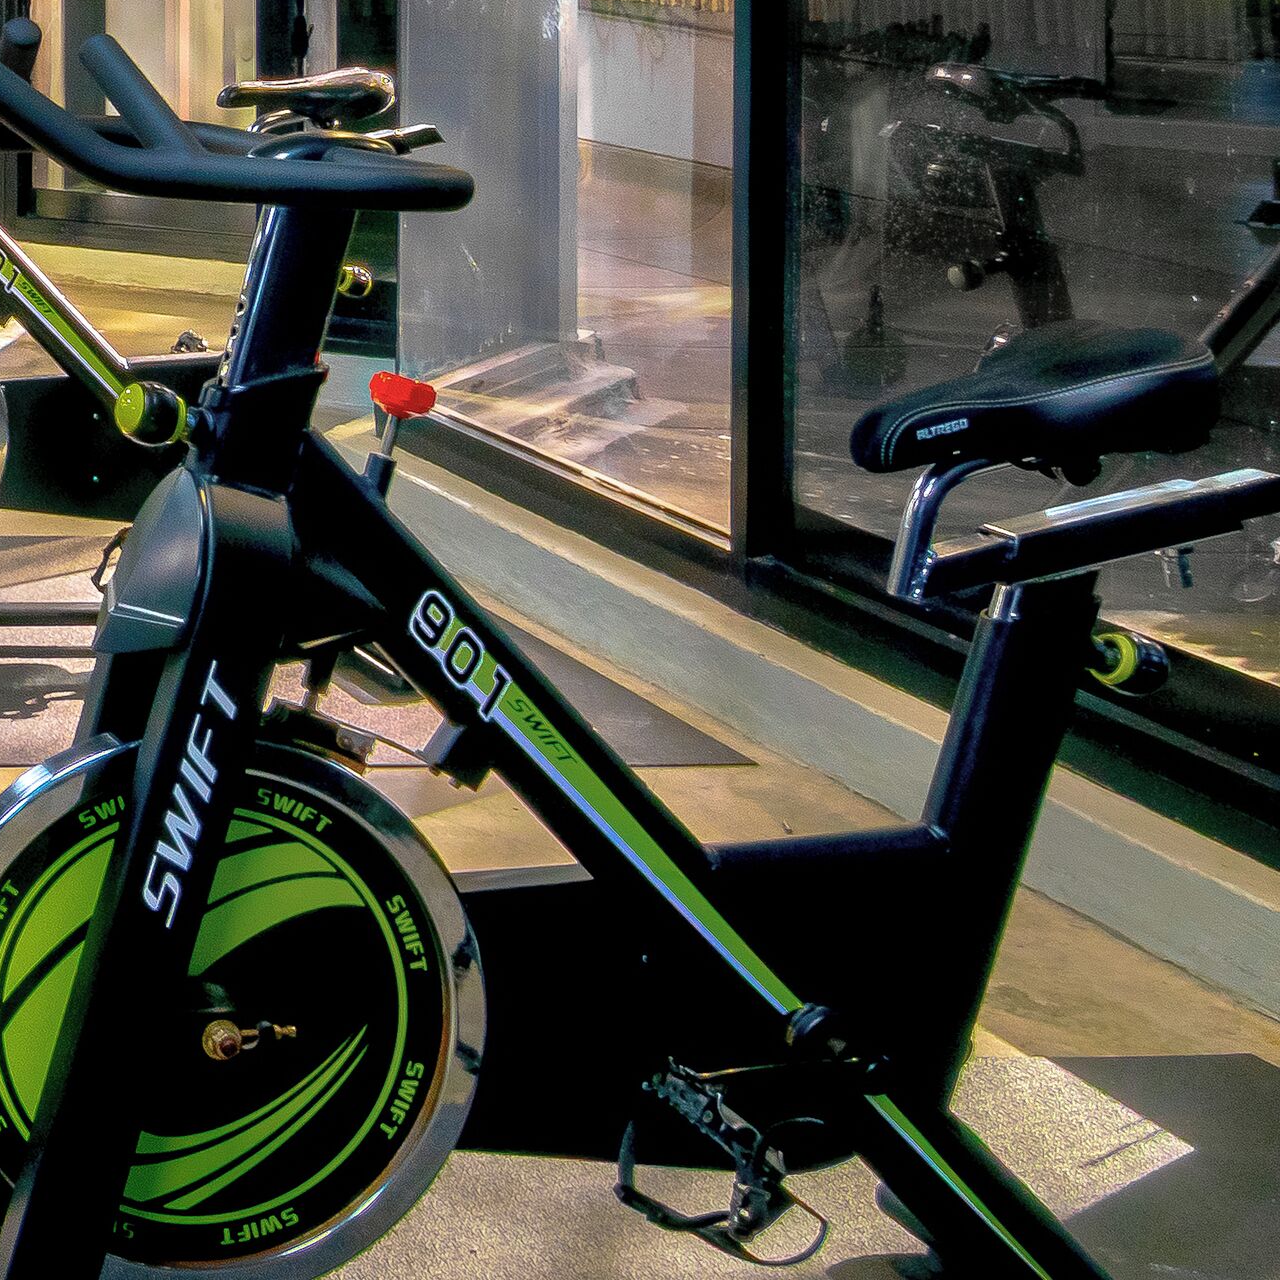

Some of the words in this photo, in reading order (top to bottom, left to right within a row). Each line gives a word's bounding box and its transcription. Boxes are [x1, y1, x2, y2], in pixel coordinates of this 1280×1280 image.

[18, 281, 53, 316] SWIFT
[408, 590, 513, 720] 901
[505, 696, 578, 766] SWIFT
[78, 794, 126, 831] SWI
[142, 659, 238, 929] SWIFT
[256, 788, 334, 834] SWIFT
[384, 894, 429, 972] SWIFT
[379, 1061, 426, 1141] SWIFT
[220, 1206, 301, 1246] SWIFT
